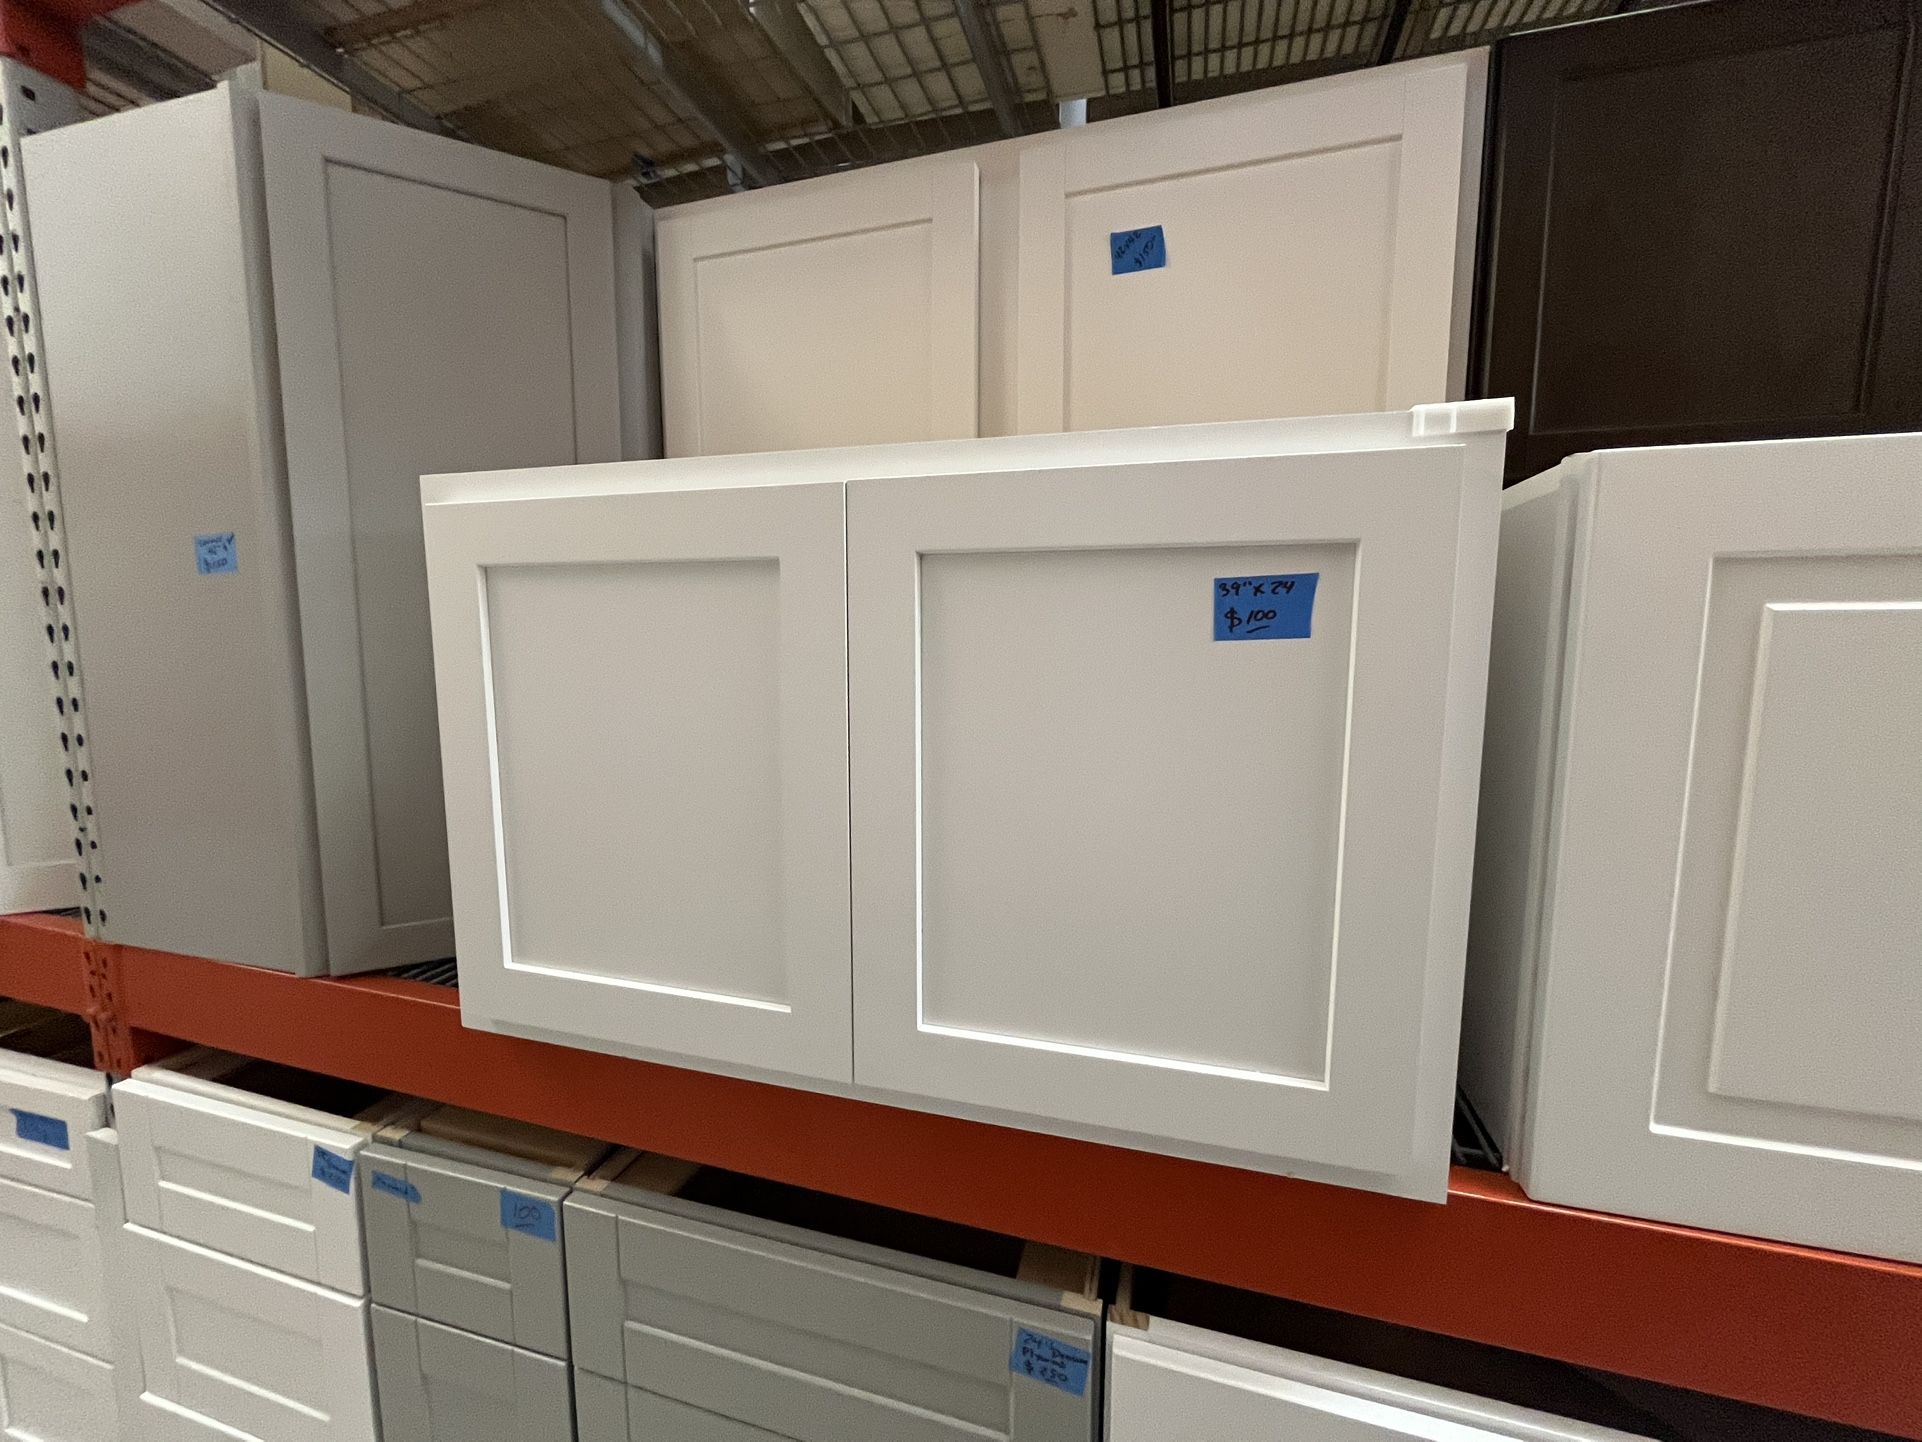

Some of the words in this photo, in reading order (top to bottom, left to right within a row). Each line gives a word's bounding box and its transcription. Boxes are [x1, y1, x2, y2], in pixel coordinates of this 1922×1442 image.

[1218, 581, 1253, 597] 39"
[1270, 580, 1296, 594] 24
[513, 1202, 541, 1220] 100
